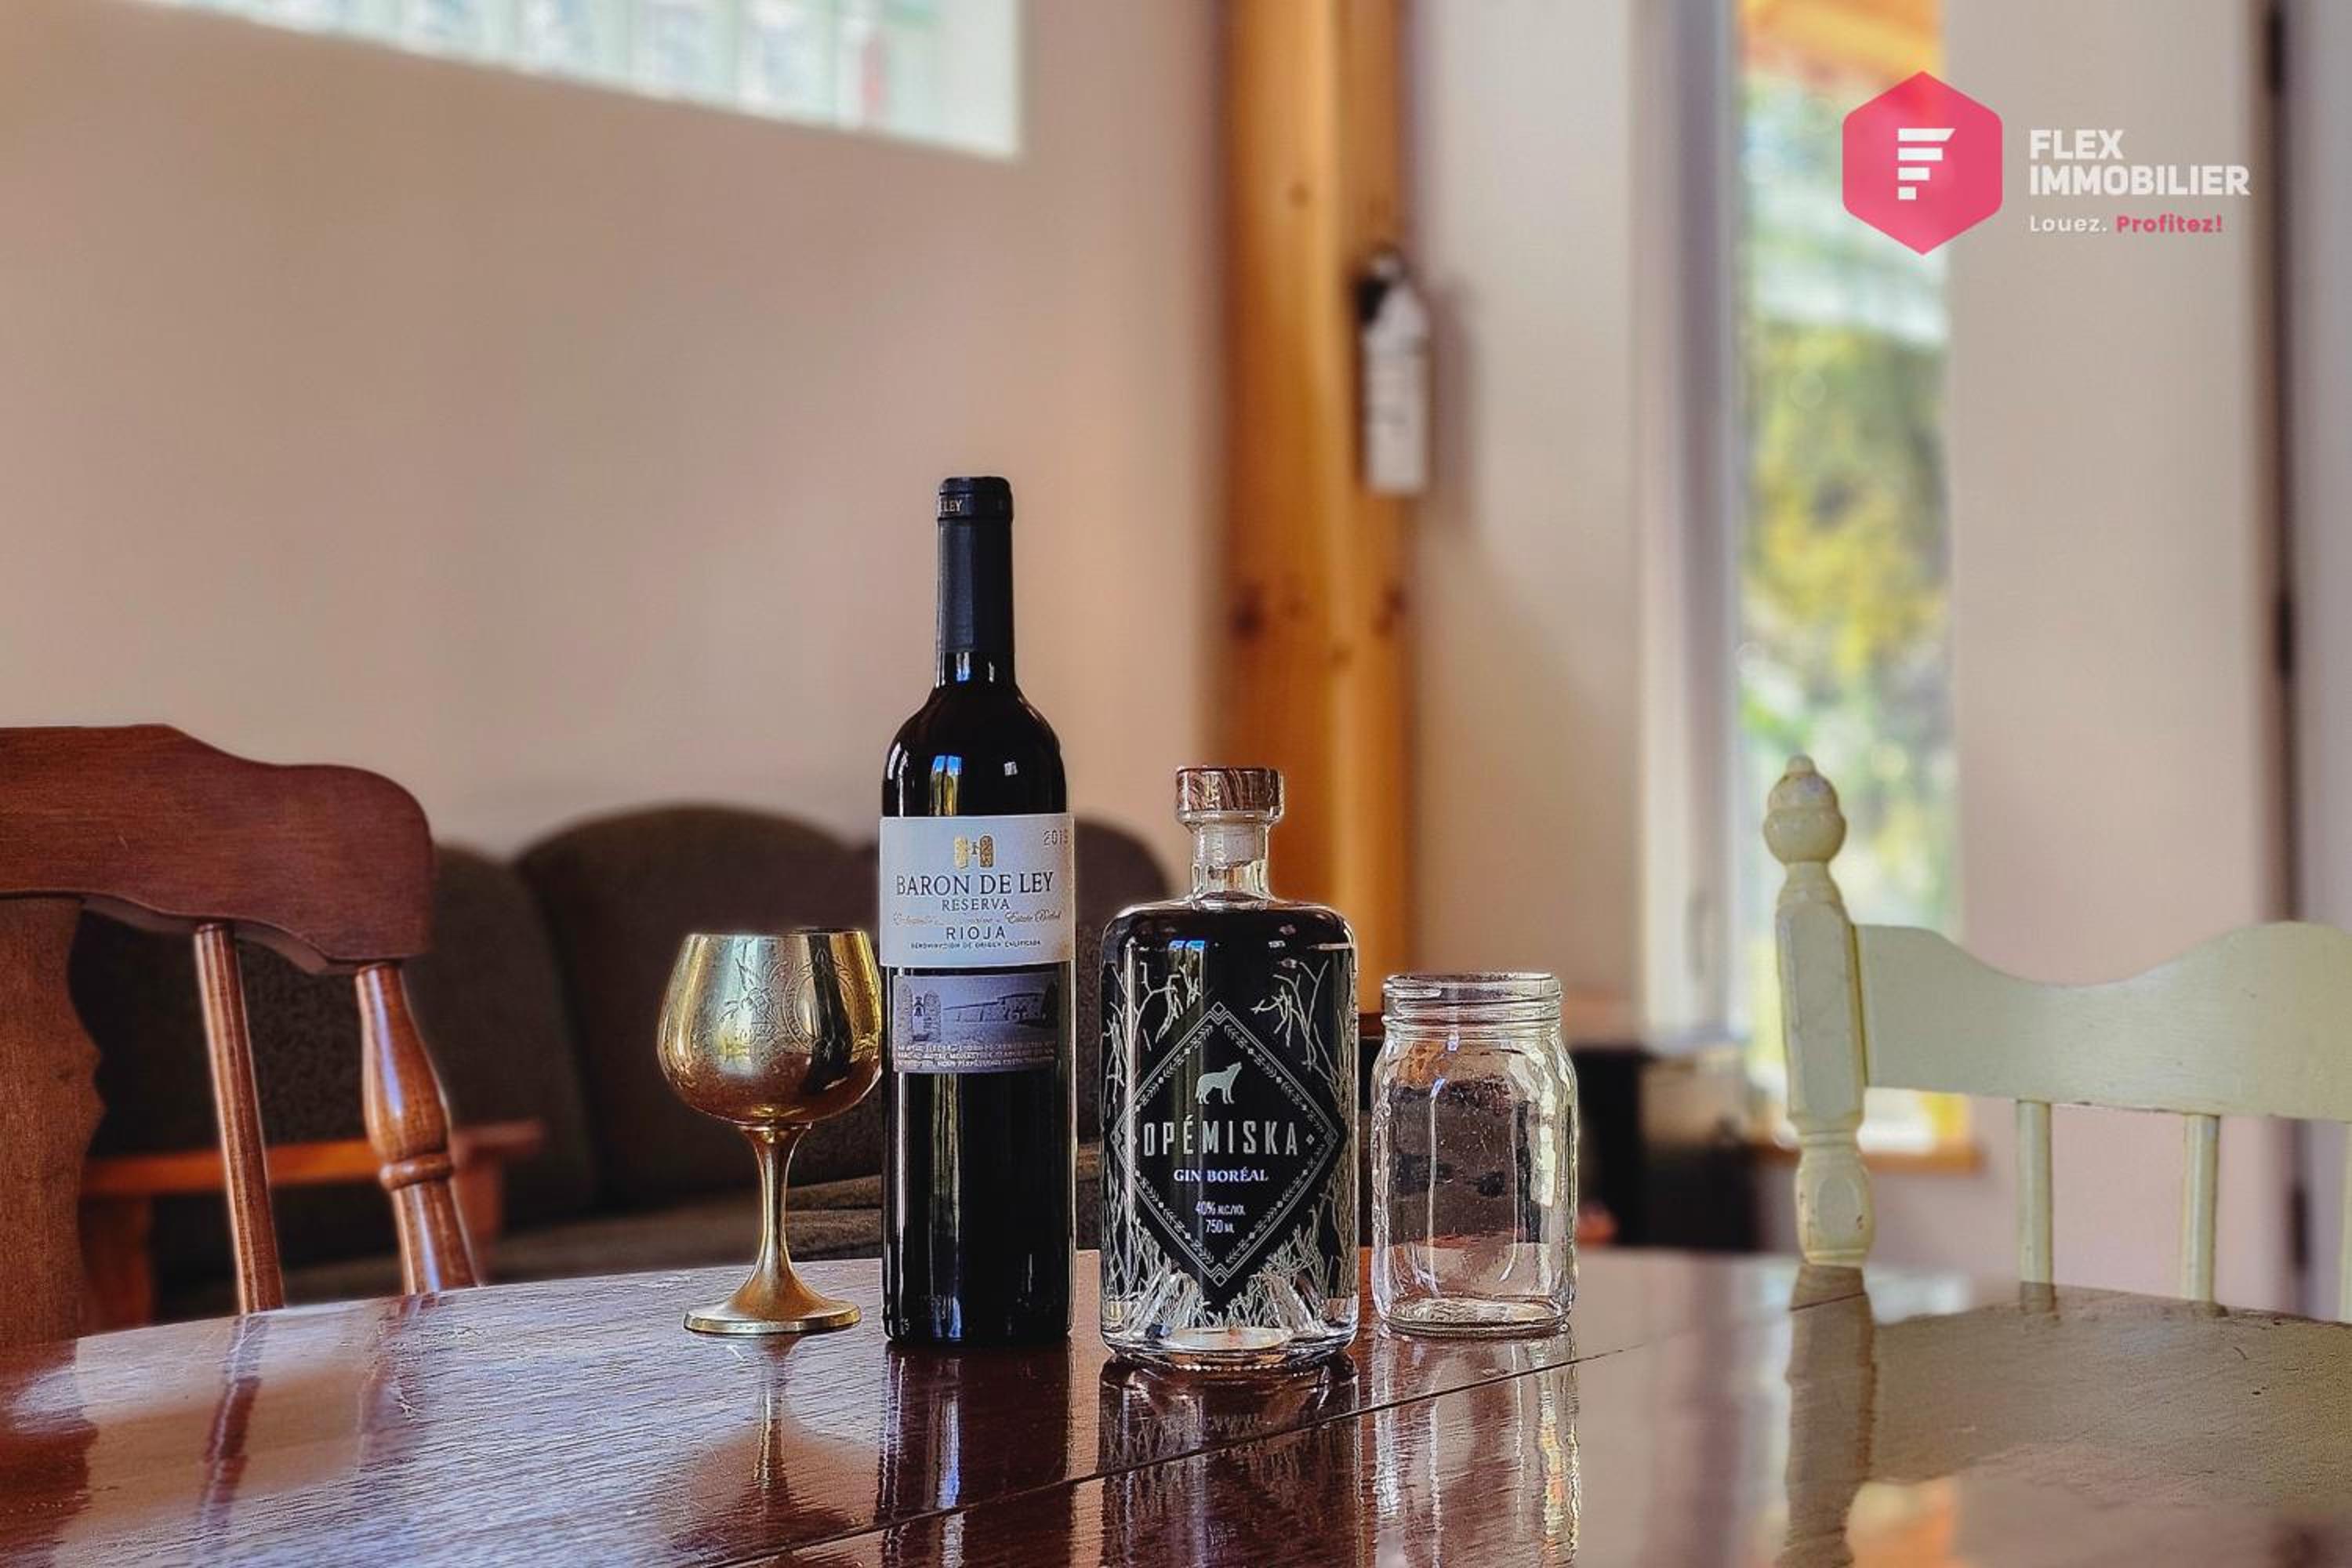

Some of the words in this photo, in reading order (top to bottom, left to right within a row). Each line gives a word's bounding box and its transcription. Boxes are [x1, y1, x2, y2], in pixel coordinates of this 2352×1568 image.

[896, 875, 970, 896] BARON
[979, 873, 1012, 895] DE
[1019, 871, 1054, 893] LEY
[942, 898, 1010, 912] RESERVA
[946, 926, 1006, 940] RIOJA
[1144, 1114, 1298, 1156] OPÉMISKA
[1174, 1170, 1201, 1181] GIN
[1207, 1166, 1269, 1182] BORÉAL
[1195, 1201, 1216, 1215] 40%
